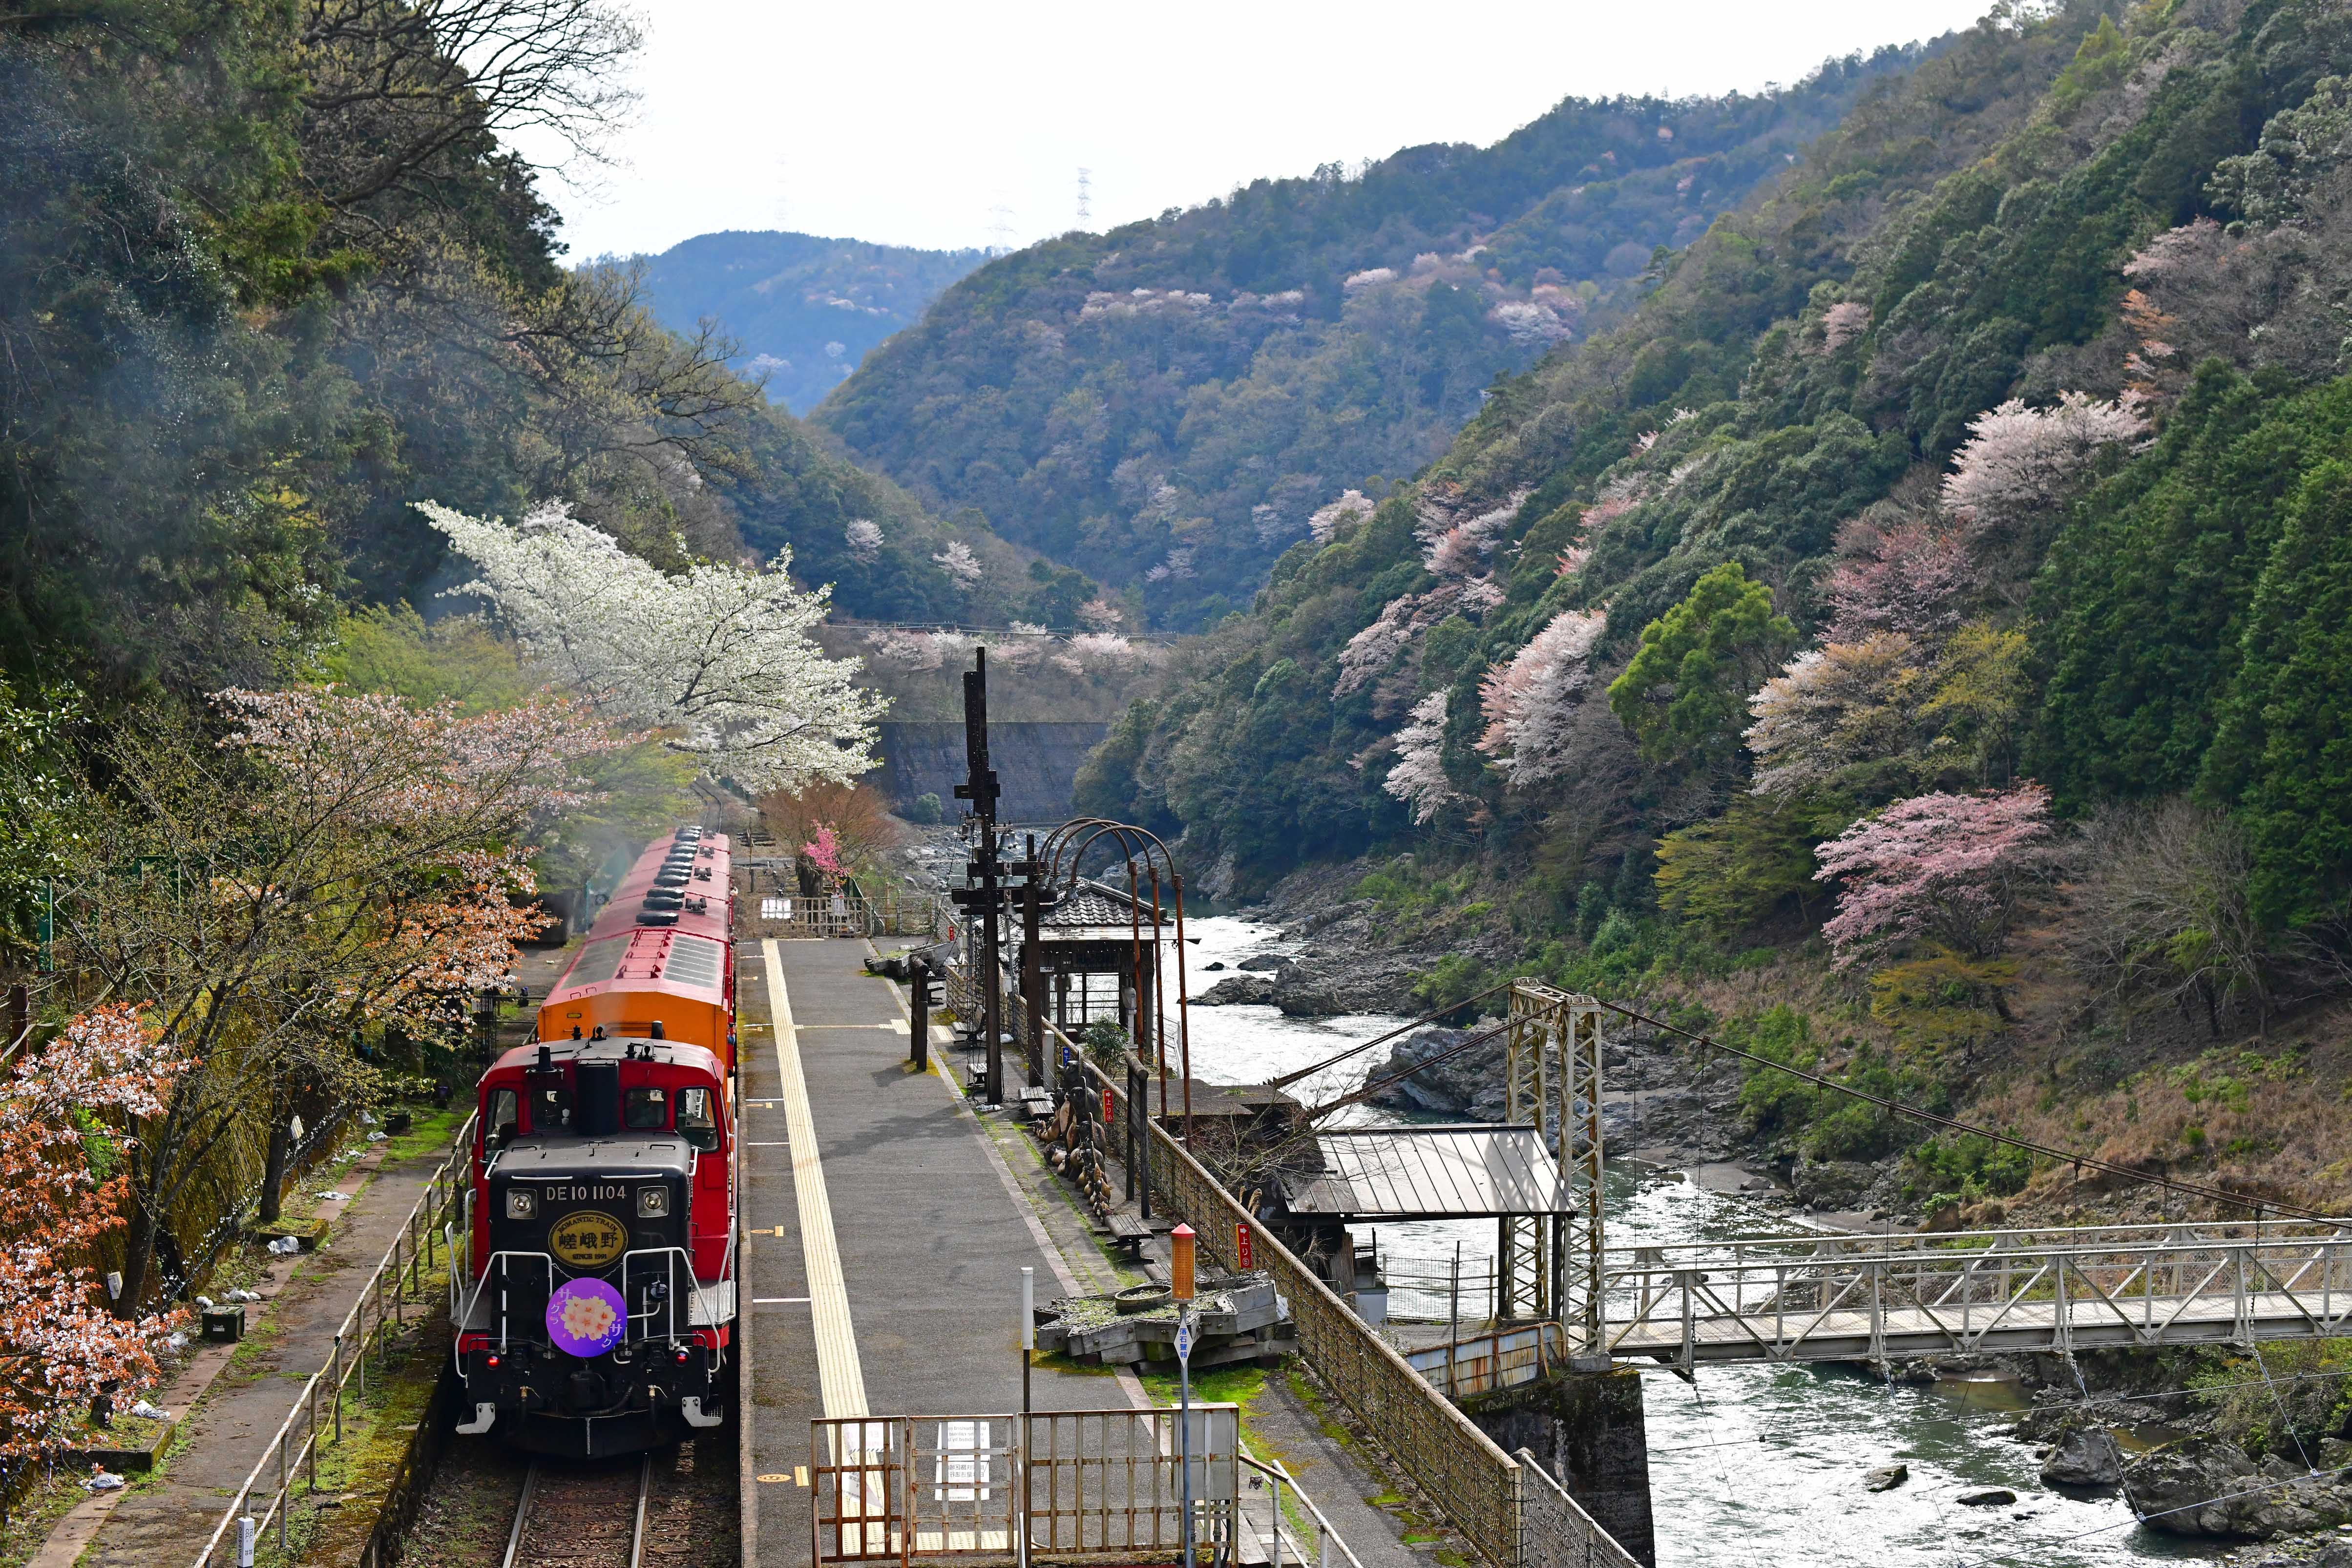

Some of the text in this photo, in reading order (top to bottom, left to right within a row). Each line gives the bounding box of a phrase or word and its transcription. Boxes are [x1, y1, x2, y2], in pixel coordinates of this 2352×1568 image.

[593, 1186, 626, 1200] 1104
[557, 1216, 618, 1233] ROMANTIC TRAIN
[559, 1232, 618, 1250] 嵯峨野
